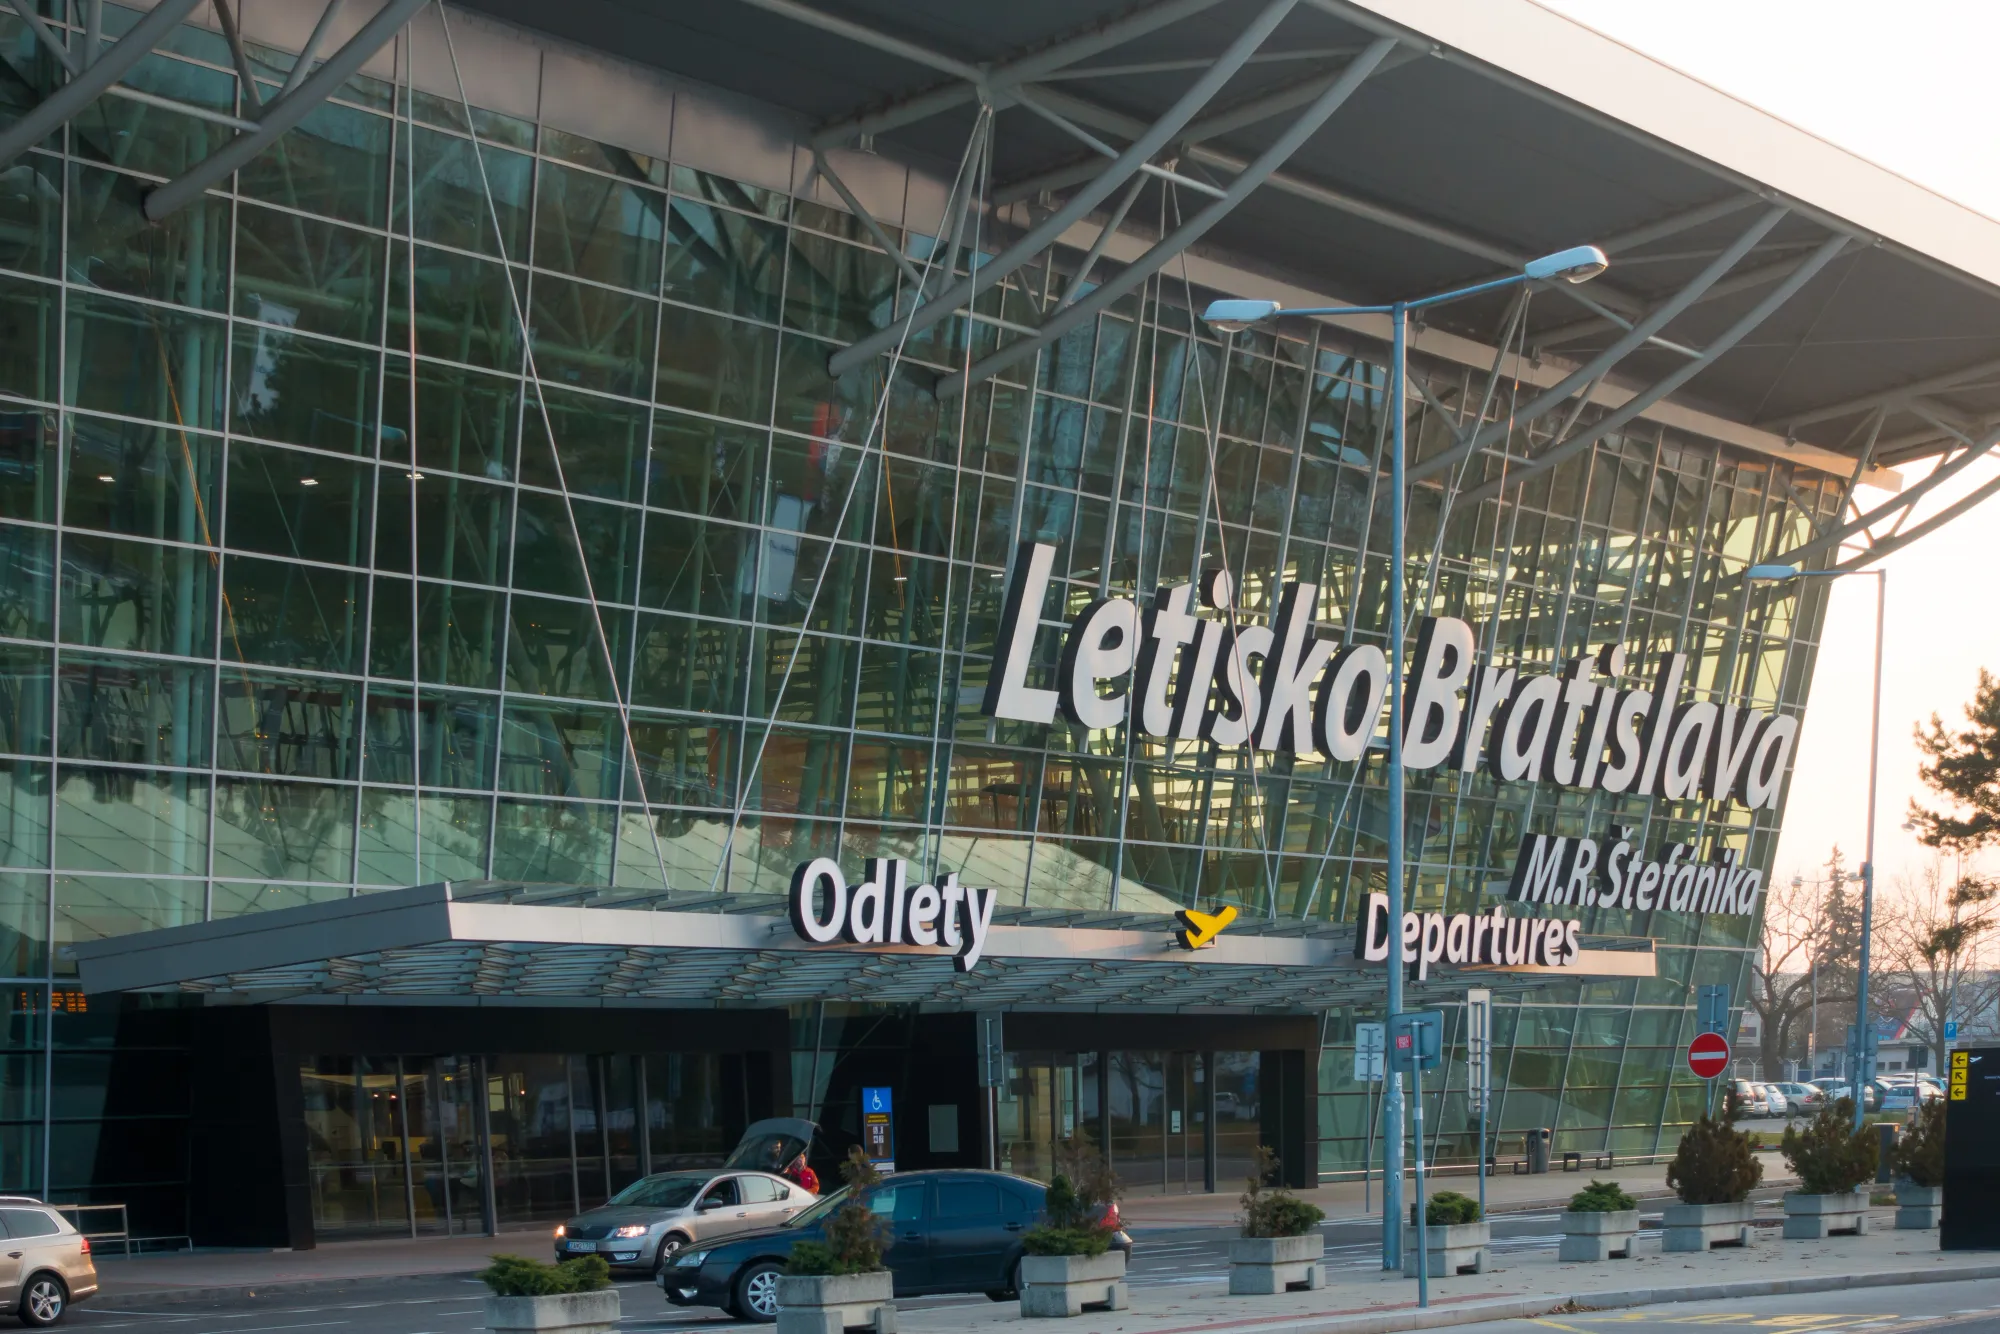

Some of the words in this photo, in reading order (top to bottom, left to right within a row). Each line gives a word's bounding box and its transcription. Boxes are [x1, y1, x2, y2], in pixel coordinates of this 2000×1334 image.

[983, 542, 1388, 762] Letisko
[1402, 616, 1798, 810] Bratislava
[790, 857, 998, 972] Odlety
[1357, 892, 1581, 981] Departures
